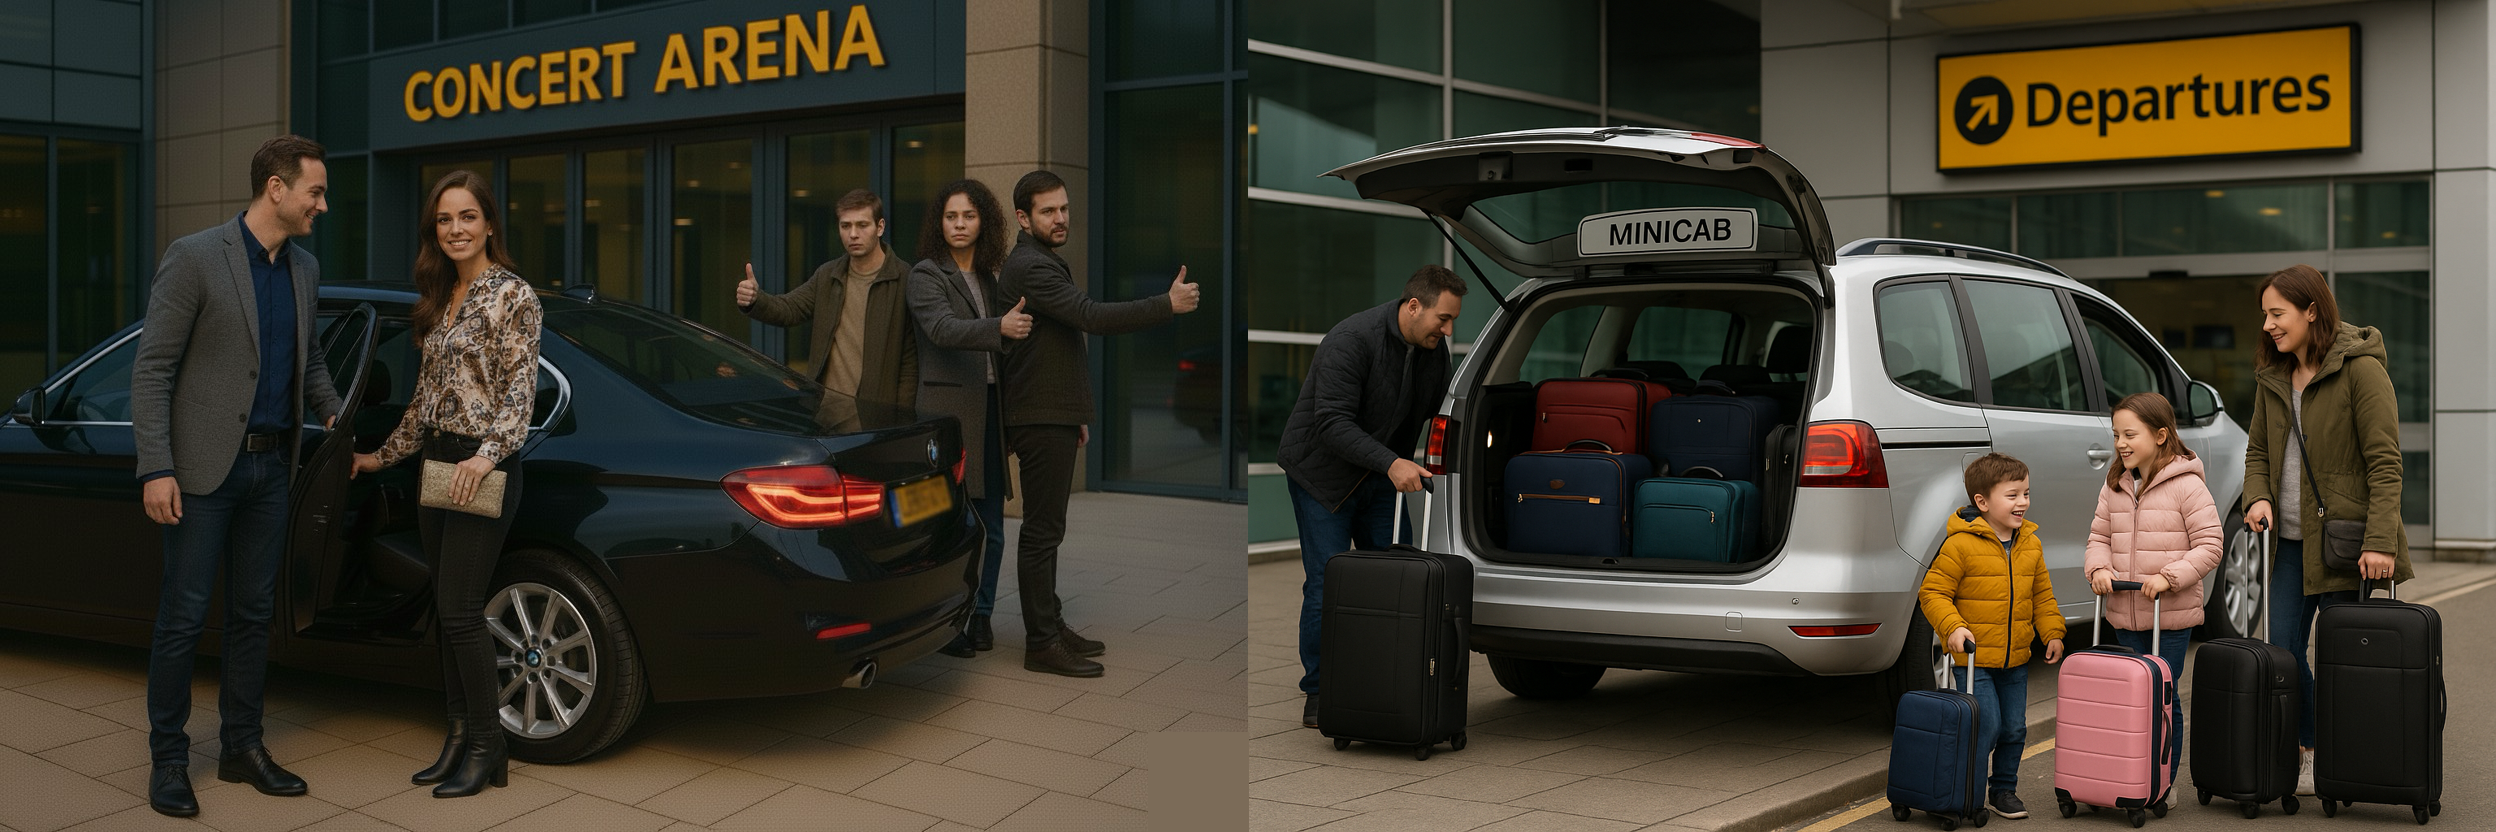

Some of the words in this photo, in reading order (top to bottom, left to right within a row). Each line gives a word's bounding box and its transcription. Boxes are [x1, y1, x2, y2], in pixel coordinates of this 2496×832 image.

[403, 41, 636, 122] CONCERT
[654, 5, 886, 93] ARENA
[2027, 73, 2331, 137] Departures
[1609, 218, 1732, 246] MINICAB
